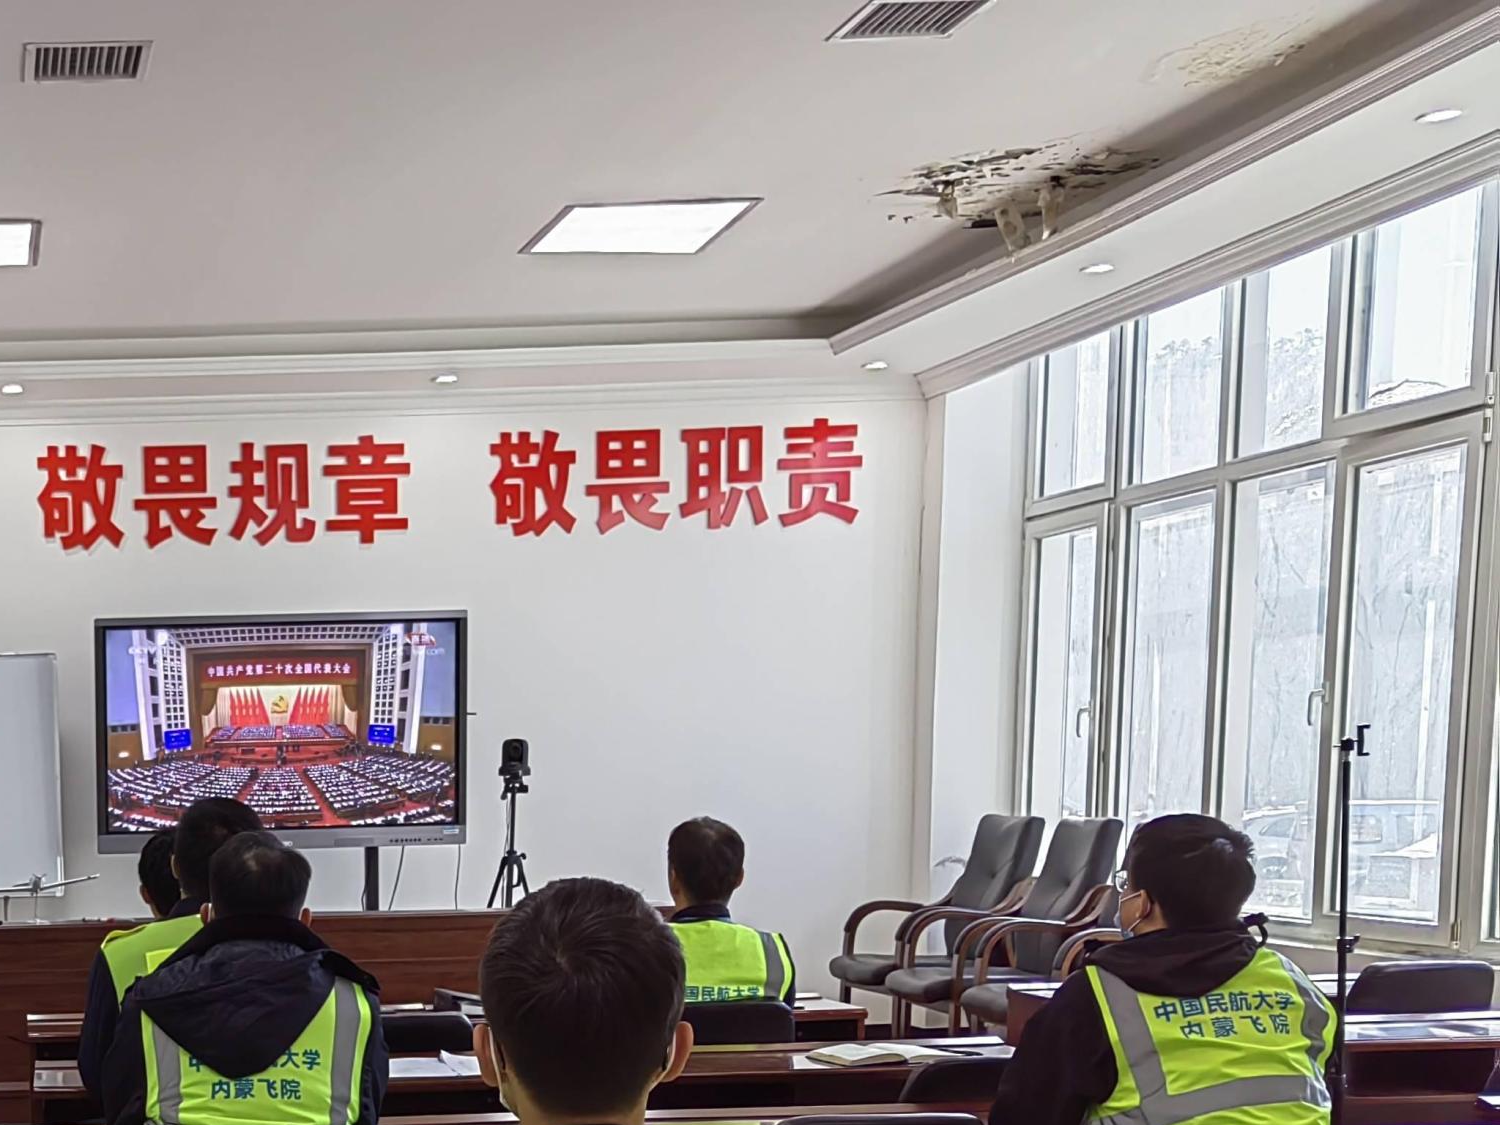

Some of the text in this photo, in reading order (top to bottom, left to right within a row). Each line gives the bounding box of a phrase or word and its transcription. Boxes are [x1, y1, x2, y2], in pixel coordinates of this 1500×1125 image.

[37, 435, 410, 551] 敬畏规章
[490, 417, 863, 538] 敬畏职责
[1153, 990, 1296, 1023] 中国民航大学
[1180, 1013, 1291, 1039] 内蒙飞院
[211, 1077, 302, 1100] 内蒙飞院
